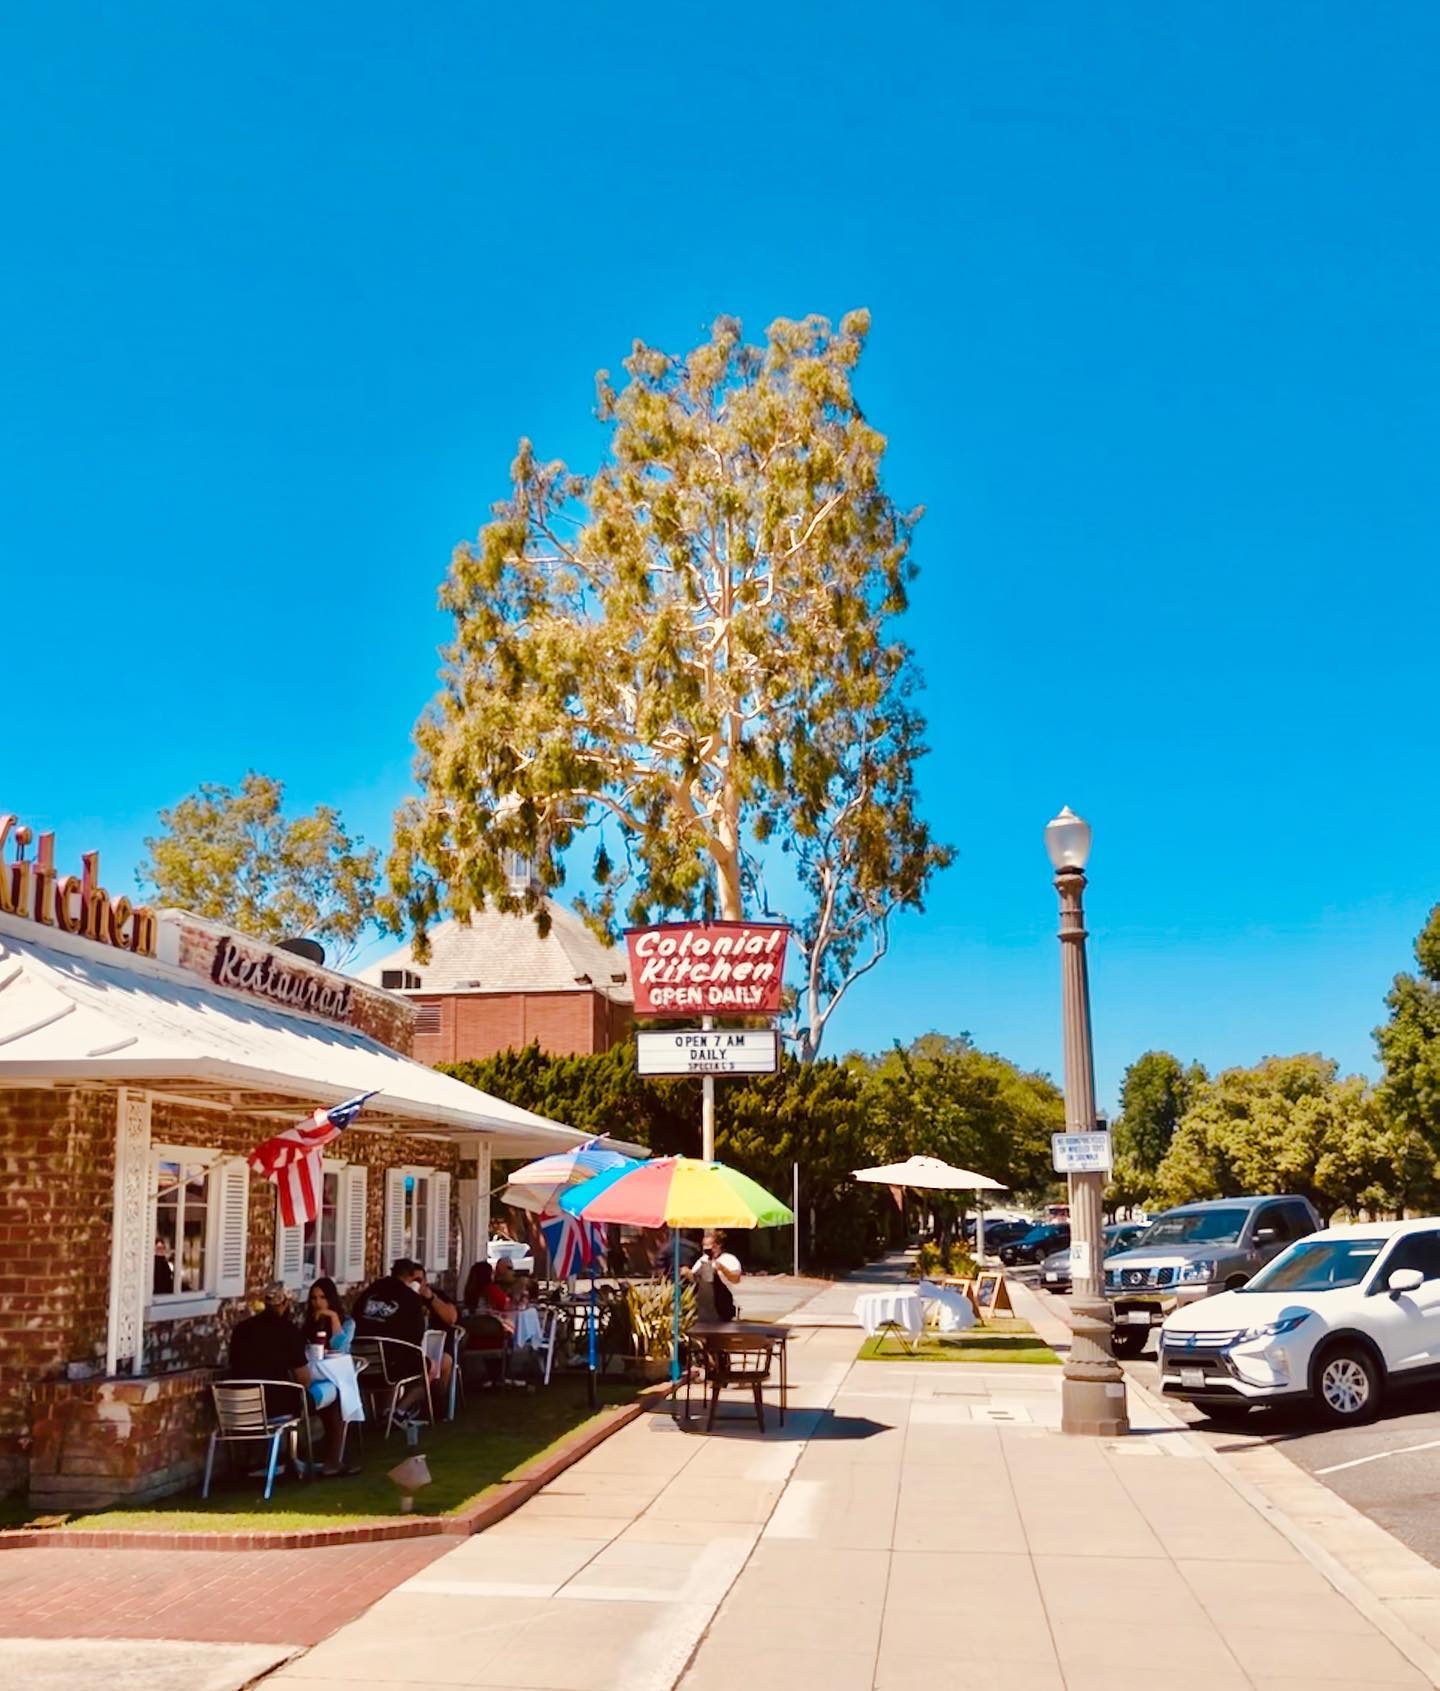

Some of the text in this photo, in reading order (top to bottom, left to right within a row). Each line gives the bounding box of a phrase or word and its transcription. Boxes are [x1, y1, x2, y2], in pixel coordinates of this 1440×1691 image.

[635, 929, 781, 958] Colonial
[212, 938, 352, 1016] Restaurant
[640, 957, 775, 984] Kitchen
[650, 986, 763, 1005] OPEN DAILY
[675, 1035, 745, 1047] OPEN 7 AM
[690, 1049, 727, 1060] DAILY
[688, 1062, 735, 1070] SPECIALS
